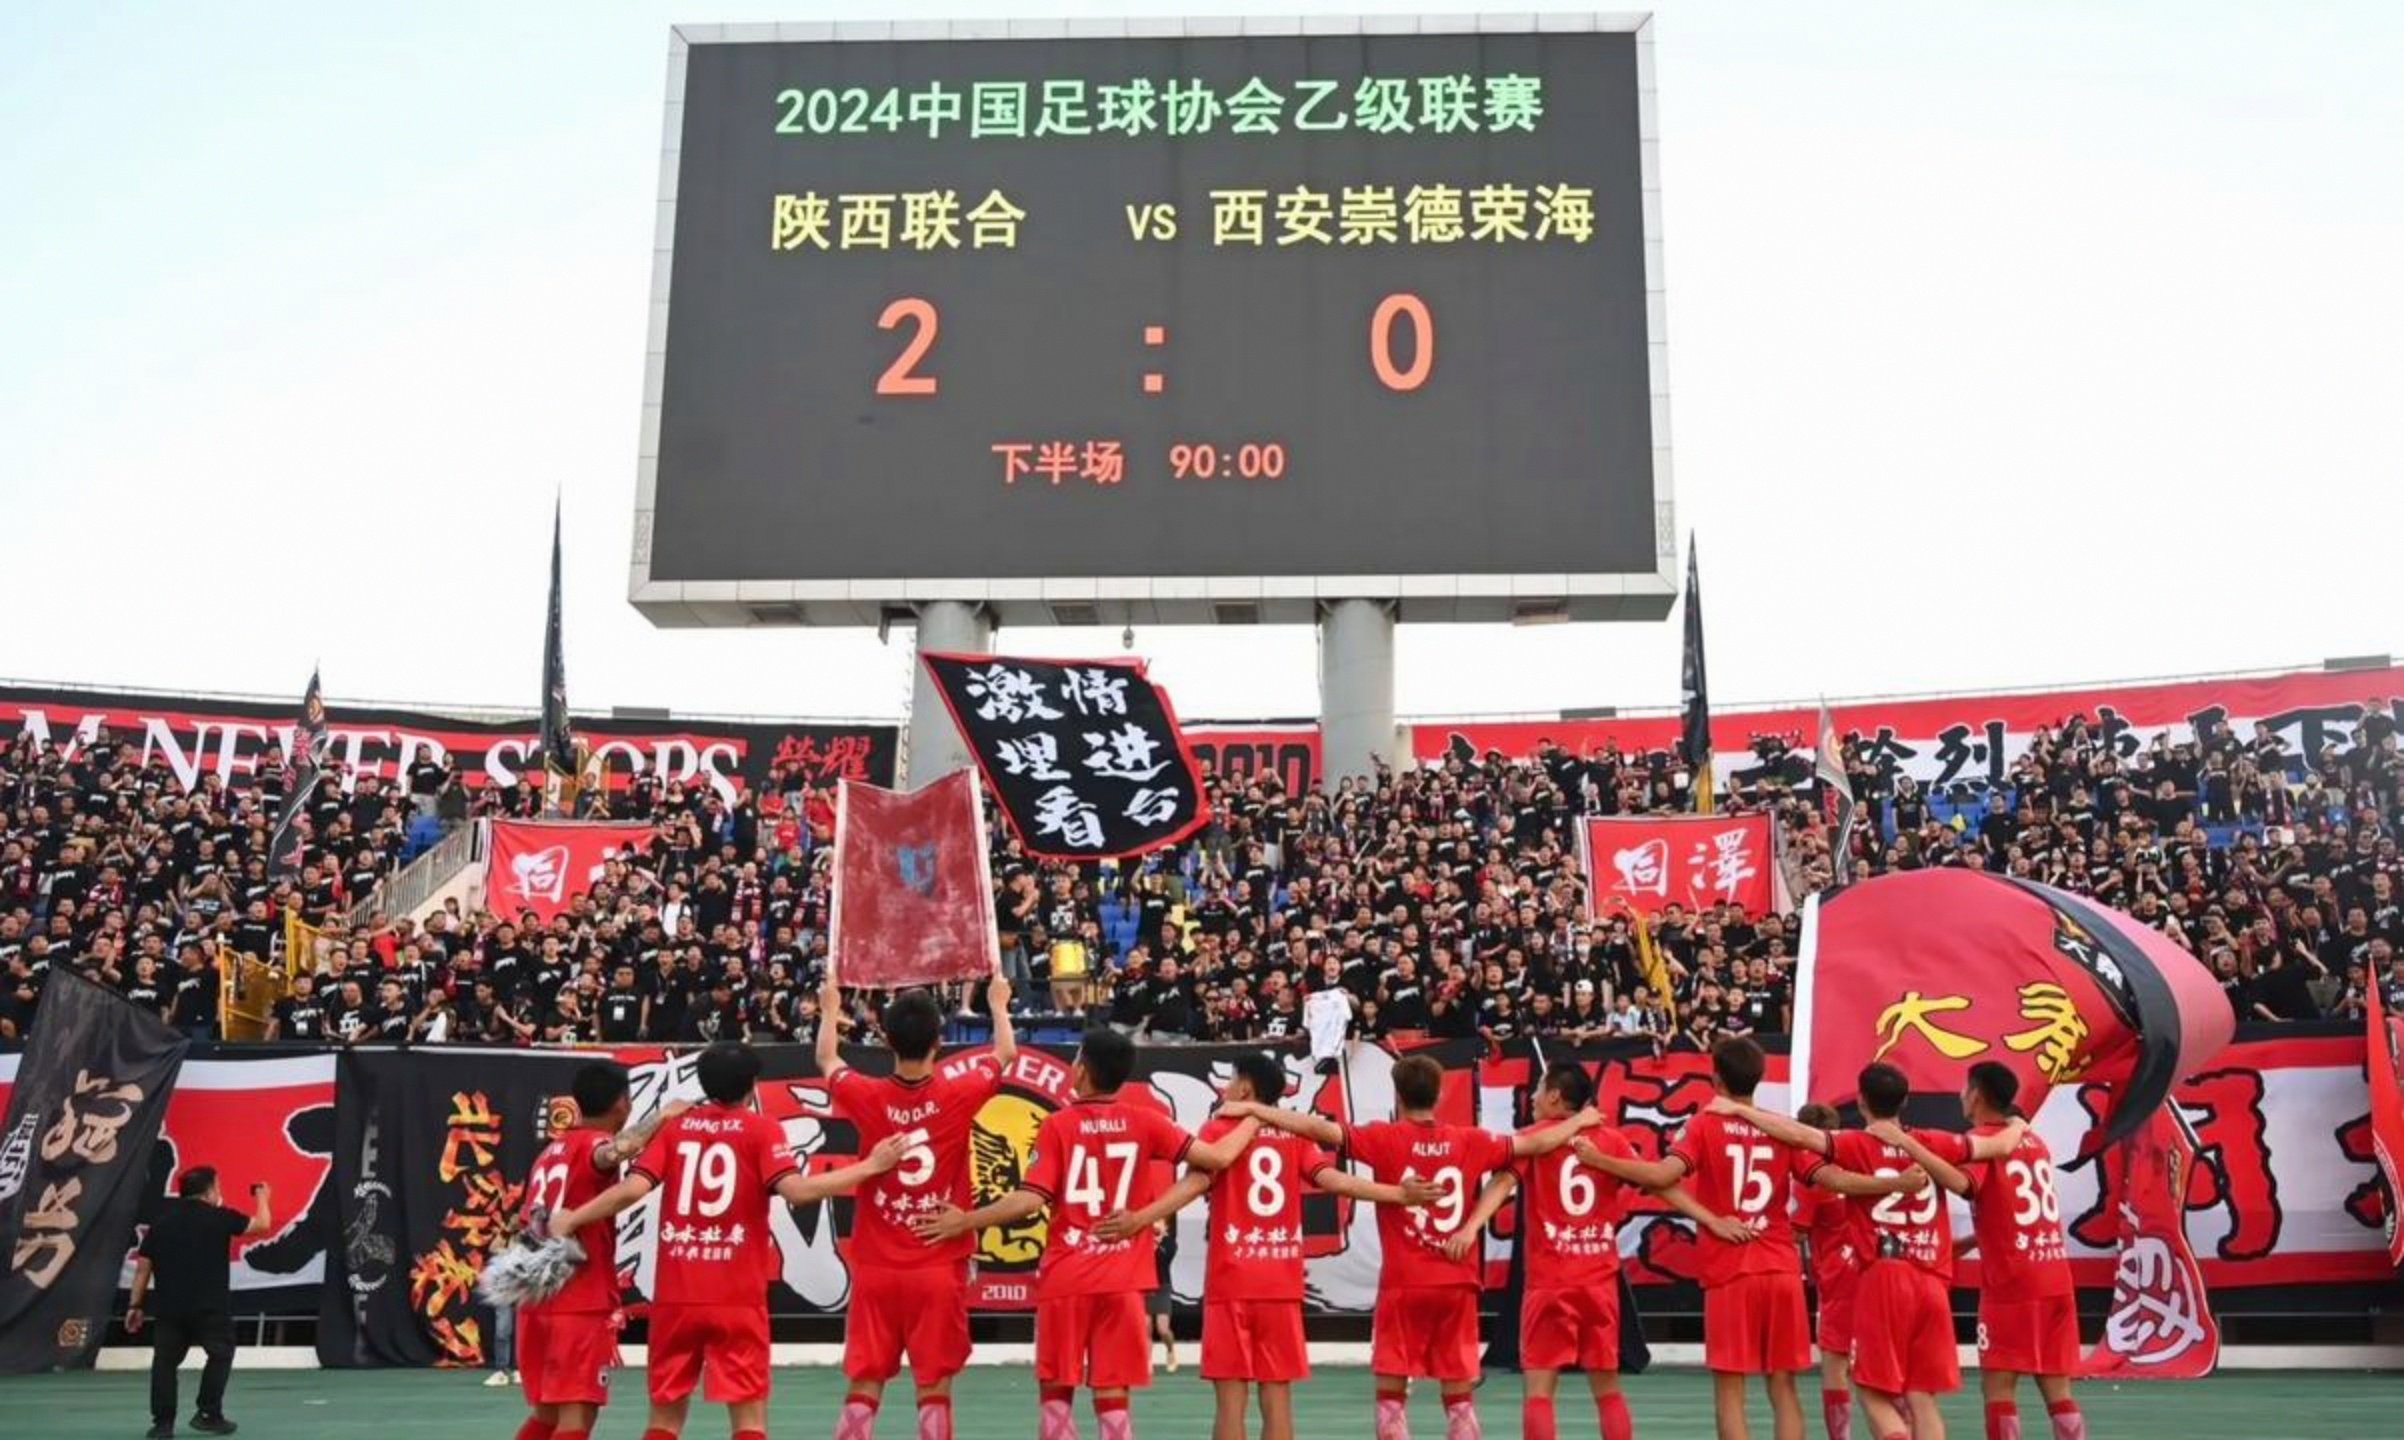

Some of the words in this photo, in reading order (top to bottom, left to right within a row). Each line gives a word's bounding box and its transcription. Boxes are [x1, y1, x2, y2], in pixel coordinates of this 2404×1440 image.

[775, 73, 1544, 139] 2024中国足球协会乙级联赛
[771, 189, 1026, 251] 陕西联合
[1125, 203, 1177, 241] VS
[1209, 182, 1595, 246] 西安崇德荣海
[875, 297, 938, 395] 2
[1370, 293, 1434, 391] 0
[991, 440, 1124, 485] 下半场
[1169, 443, 1285, 479] 90:00
[965, 663, 1129, 724] 激情
[996, 722, 1173, 782] 埋进
[1034, 785, 1179, 848] 看台
[676, 1140, 738, 1218] 19
[897, 1127, 936, 1186] 5
[1065, 1142, 1139, 1216] 47
[1247, 1145, 1286, 1217] 8
[1559, 1154, 1596, 1216] 6
[1724, 1143, 1774, 1213] 15
[2005, 1158, 2059, 1226] 38
[982, 1285, 1027, 1301] 2010
